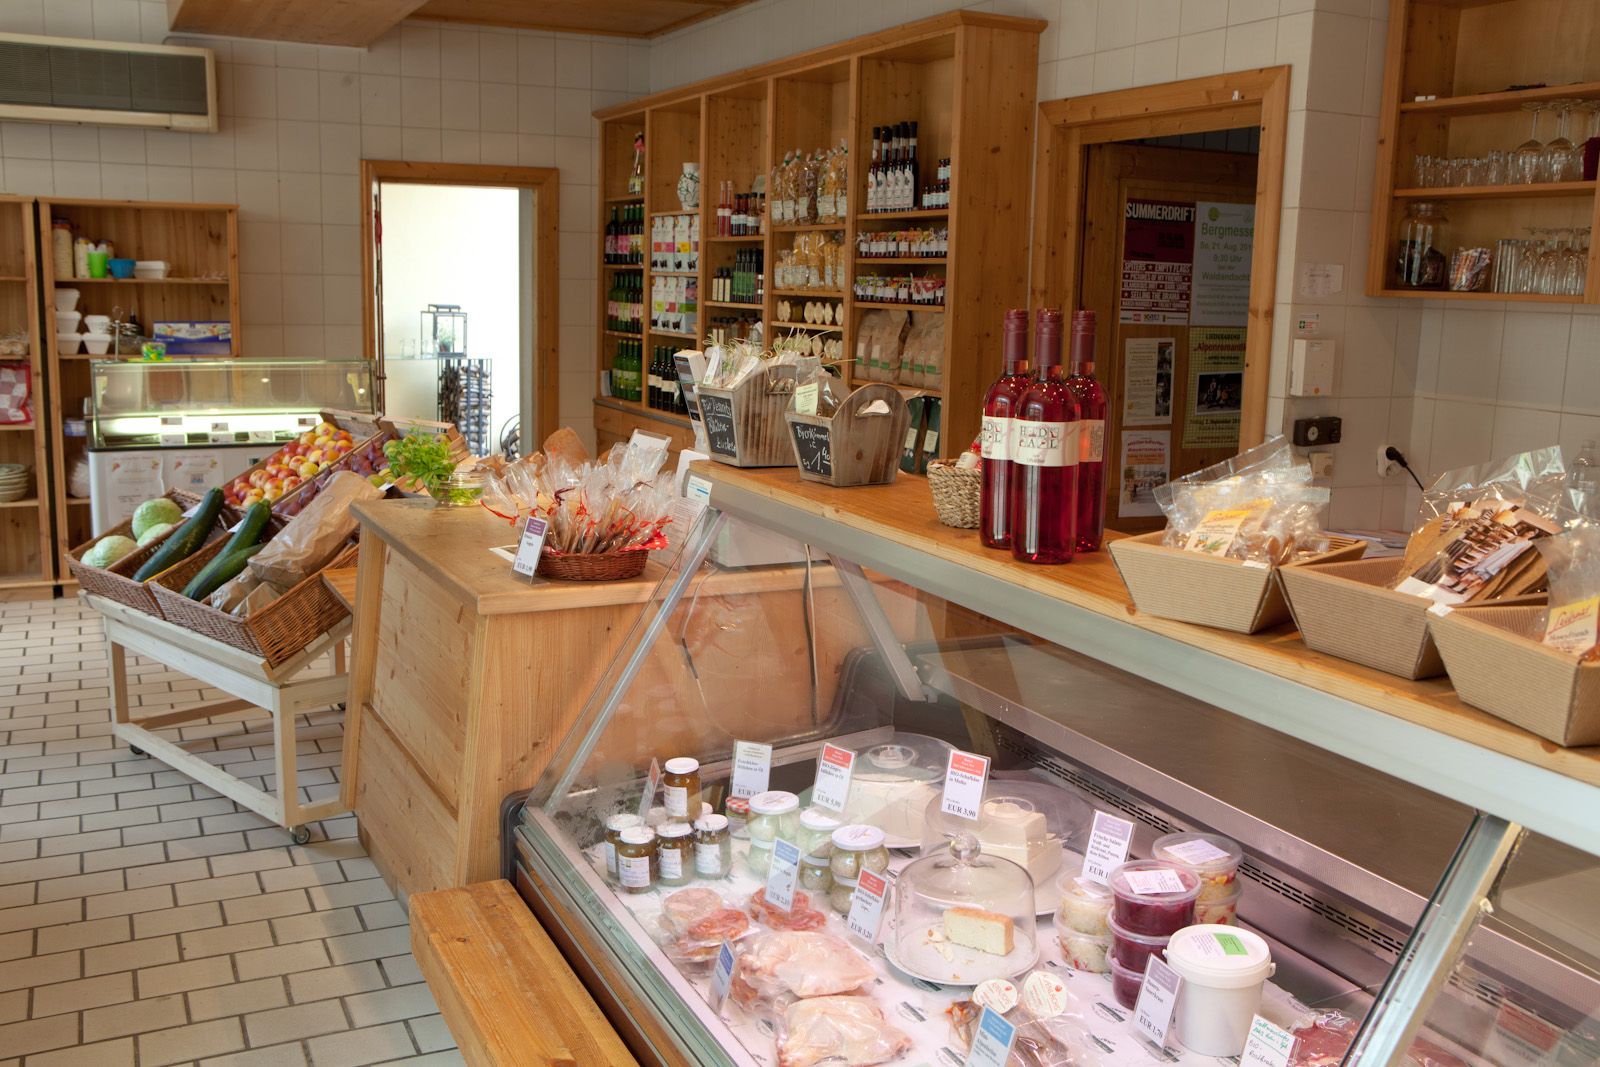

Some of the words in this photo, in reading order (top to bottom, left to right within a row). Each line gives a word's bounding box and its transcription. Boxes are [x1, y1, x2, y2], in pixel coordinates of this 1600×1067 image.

[1125, 202, 1195, 222] SUMMERDRIFT
[1201, 223, 1254, 239] Bergmesse
[947, 803, 963, 814] EUR
[1088, 865, 1104, 877] EUR
[850, 922, 863, 934] EUR
[1138, 1014, 1152, 1031] EUR
